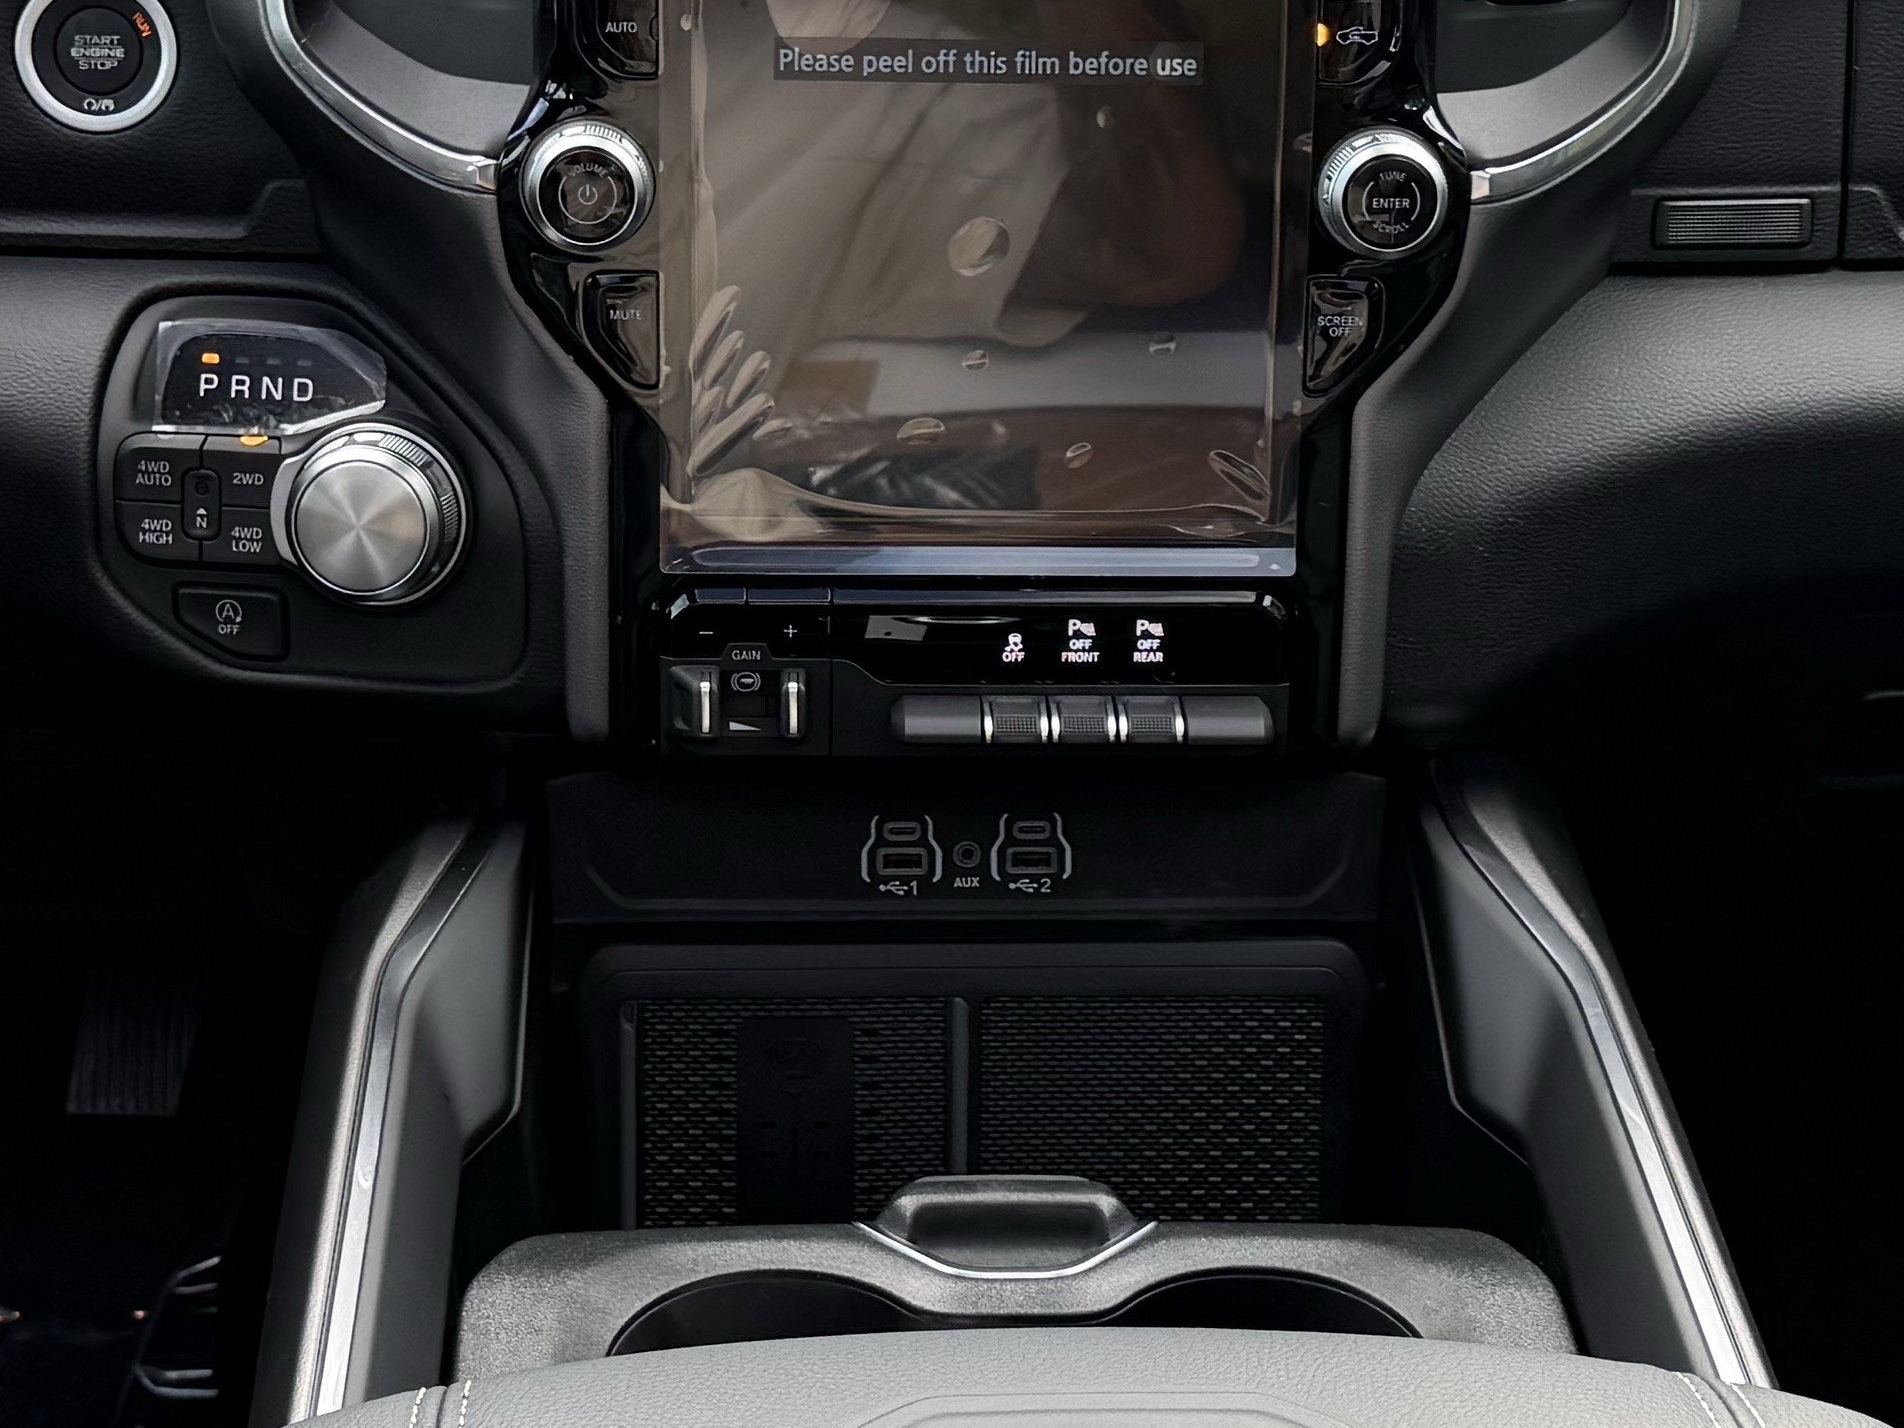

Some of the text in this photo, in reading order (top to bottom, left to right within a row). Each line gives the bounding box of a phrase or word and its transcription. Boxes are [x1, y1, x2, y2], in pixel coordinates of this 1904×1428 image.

[132, 12, 153, 39] RUN
[605, 21, 638, 35] AUTO
[73, 34, 121, 46] START
[70, 47, 126, 59] ENGINE
[78, 59, 119, 71] STOP
[778, 48, 1198, 77] Please peel off this film before use
[567, 162, 610, 180] VOLUME
[1378, 170, 1407, 183] TUNE
[1372, 197, 1411, 209] ENTER
[1372, 220, 1412, 235] SCROLL
[608, 308, 644, 323] MUTE
[1317, 315, 1364, 328] SCREEN
[1328, 326, 1353, 338] OFF
[137, 459, 171, 473] 4WD
[135, 473, 173, 488] AUTO
[232, 471, 265, 486] 2WD
[140, 518, 173, 532] 4WD
[195, 515, 208, 530] N
[138, 530, 174, 546] HIGH
[230, 526, 264, 540] 4WD
[231, 539, 264, 553] LOW
[218, 623, 241, 636] OFF
[1069, 638, 1093, 650] OFF
[1137, 638, 1161, 650] OFF
[731, 649, 762, 662] GAIN
[1001, 651, 1026, 664] OFF
[1061, 651, 1100, 664] FRONT
[1133, 651, 1164, 664] REAR
[953, 876, 981, 888] AUX
